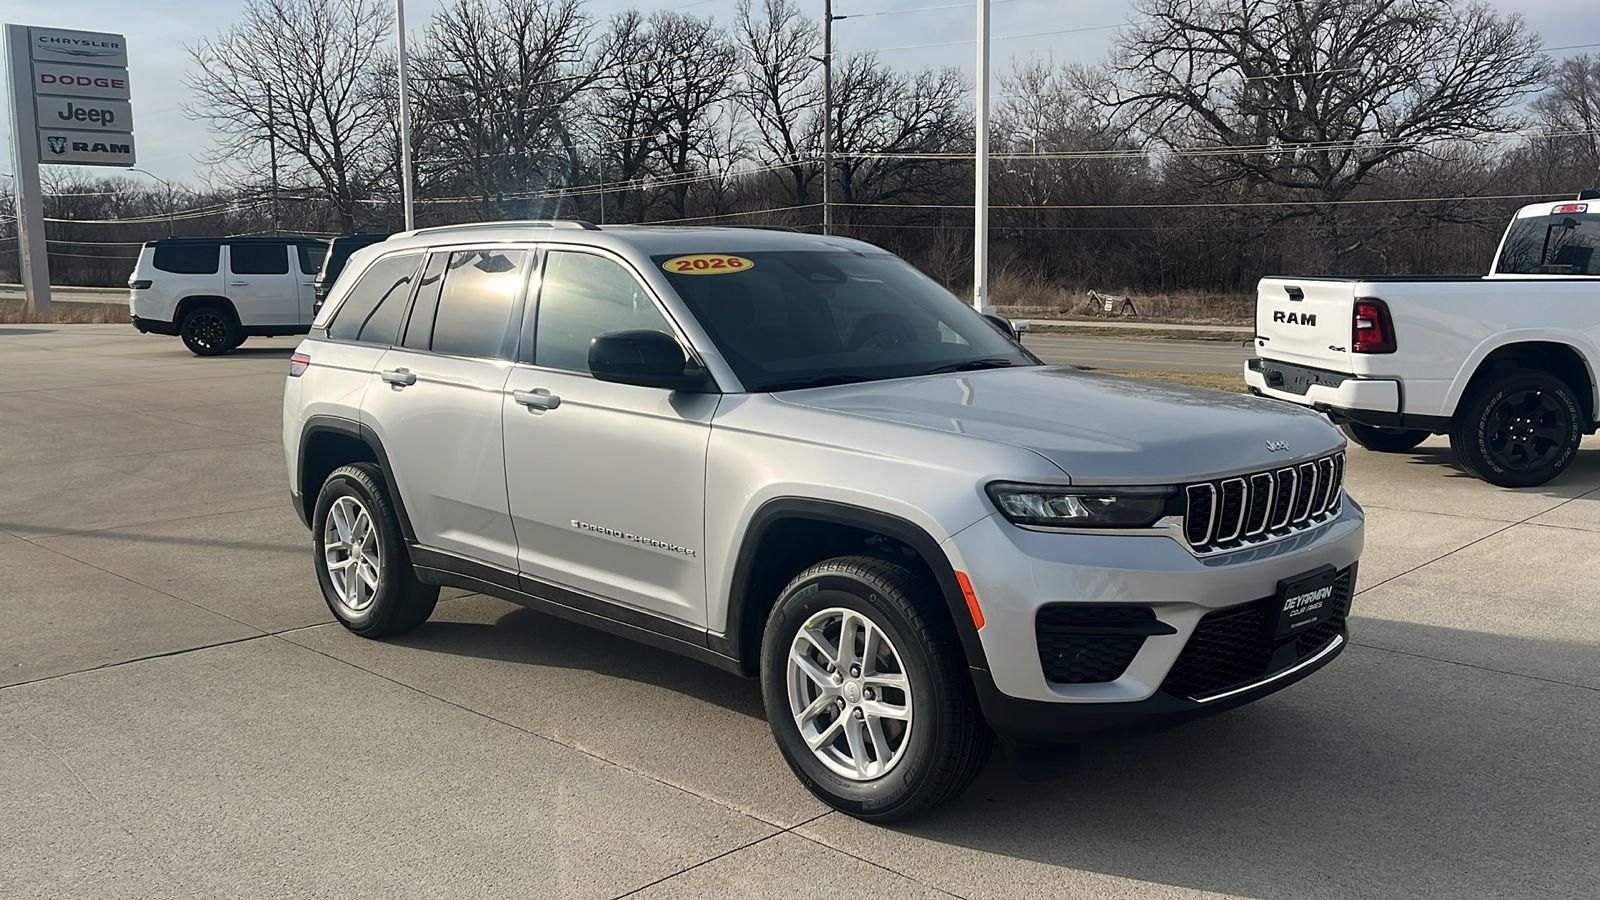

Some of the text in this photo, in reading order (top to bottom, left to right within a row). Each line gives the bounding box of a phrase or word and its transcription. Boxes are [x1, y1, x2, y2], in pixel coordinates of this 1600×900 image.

[39, 36, 120, 49] CHRYSLER
[41, 74, 125, 89] DODGE
[58, 102, 115, 126] Jeep
[72, 142, 131, 154] RAM
[675, 257, 744, 272] 2026
[1273, 310, 1317, 327] RAM
[580, 522, 625, 539] GRAND
